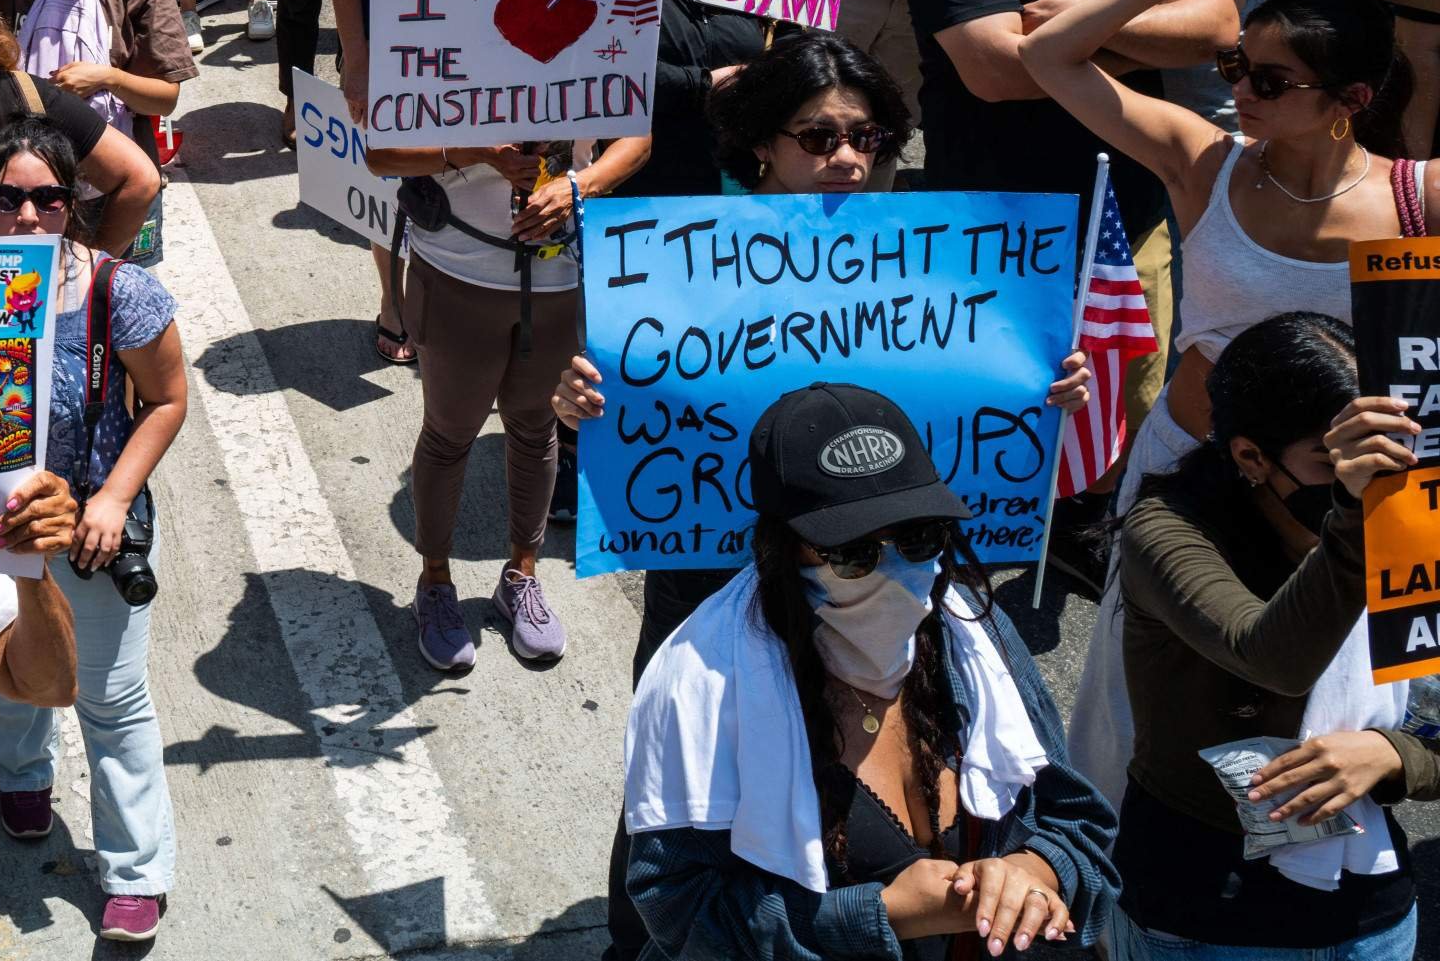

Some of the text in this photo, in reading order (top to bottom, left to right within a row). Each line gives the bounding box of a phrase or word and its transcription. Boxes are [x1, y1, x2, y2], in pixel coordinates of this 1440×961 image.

[389, 46, 469, 82] THE
[371, 71, 649, 134] CONSTITUTION
[604, 217, 1067, 289] I THOUGHT THE
[619, 289, 998, 388] GOVERNMENT
[91, 343, 105, 390] Canon
[617, 400, 739, 445] WAS
[827, 427, 885, 449] CHAMPIONSHIP
[834, 434, 899, 466] NHRA
[840, 454, 900, 474] DRAG RACING
[599, 524, 708, 555] what
